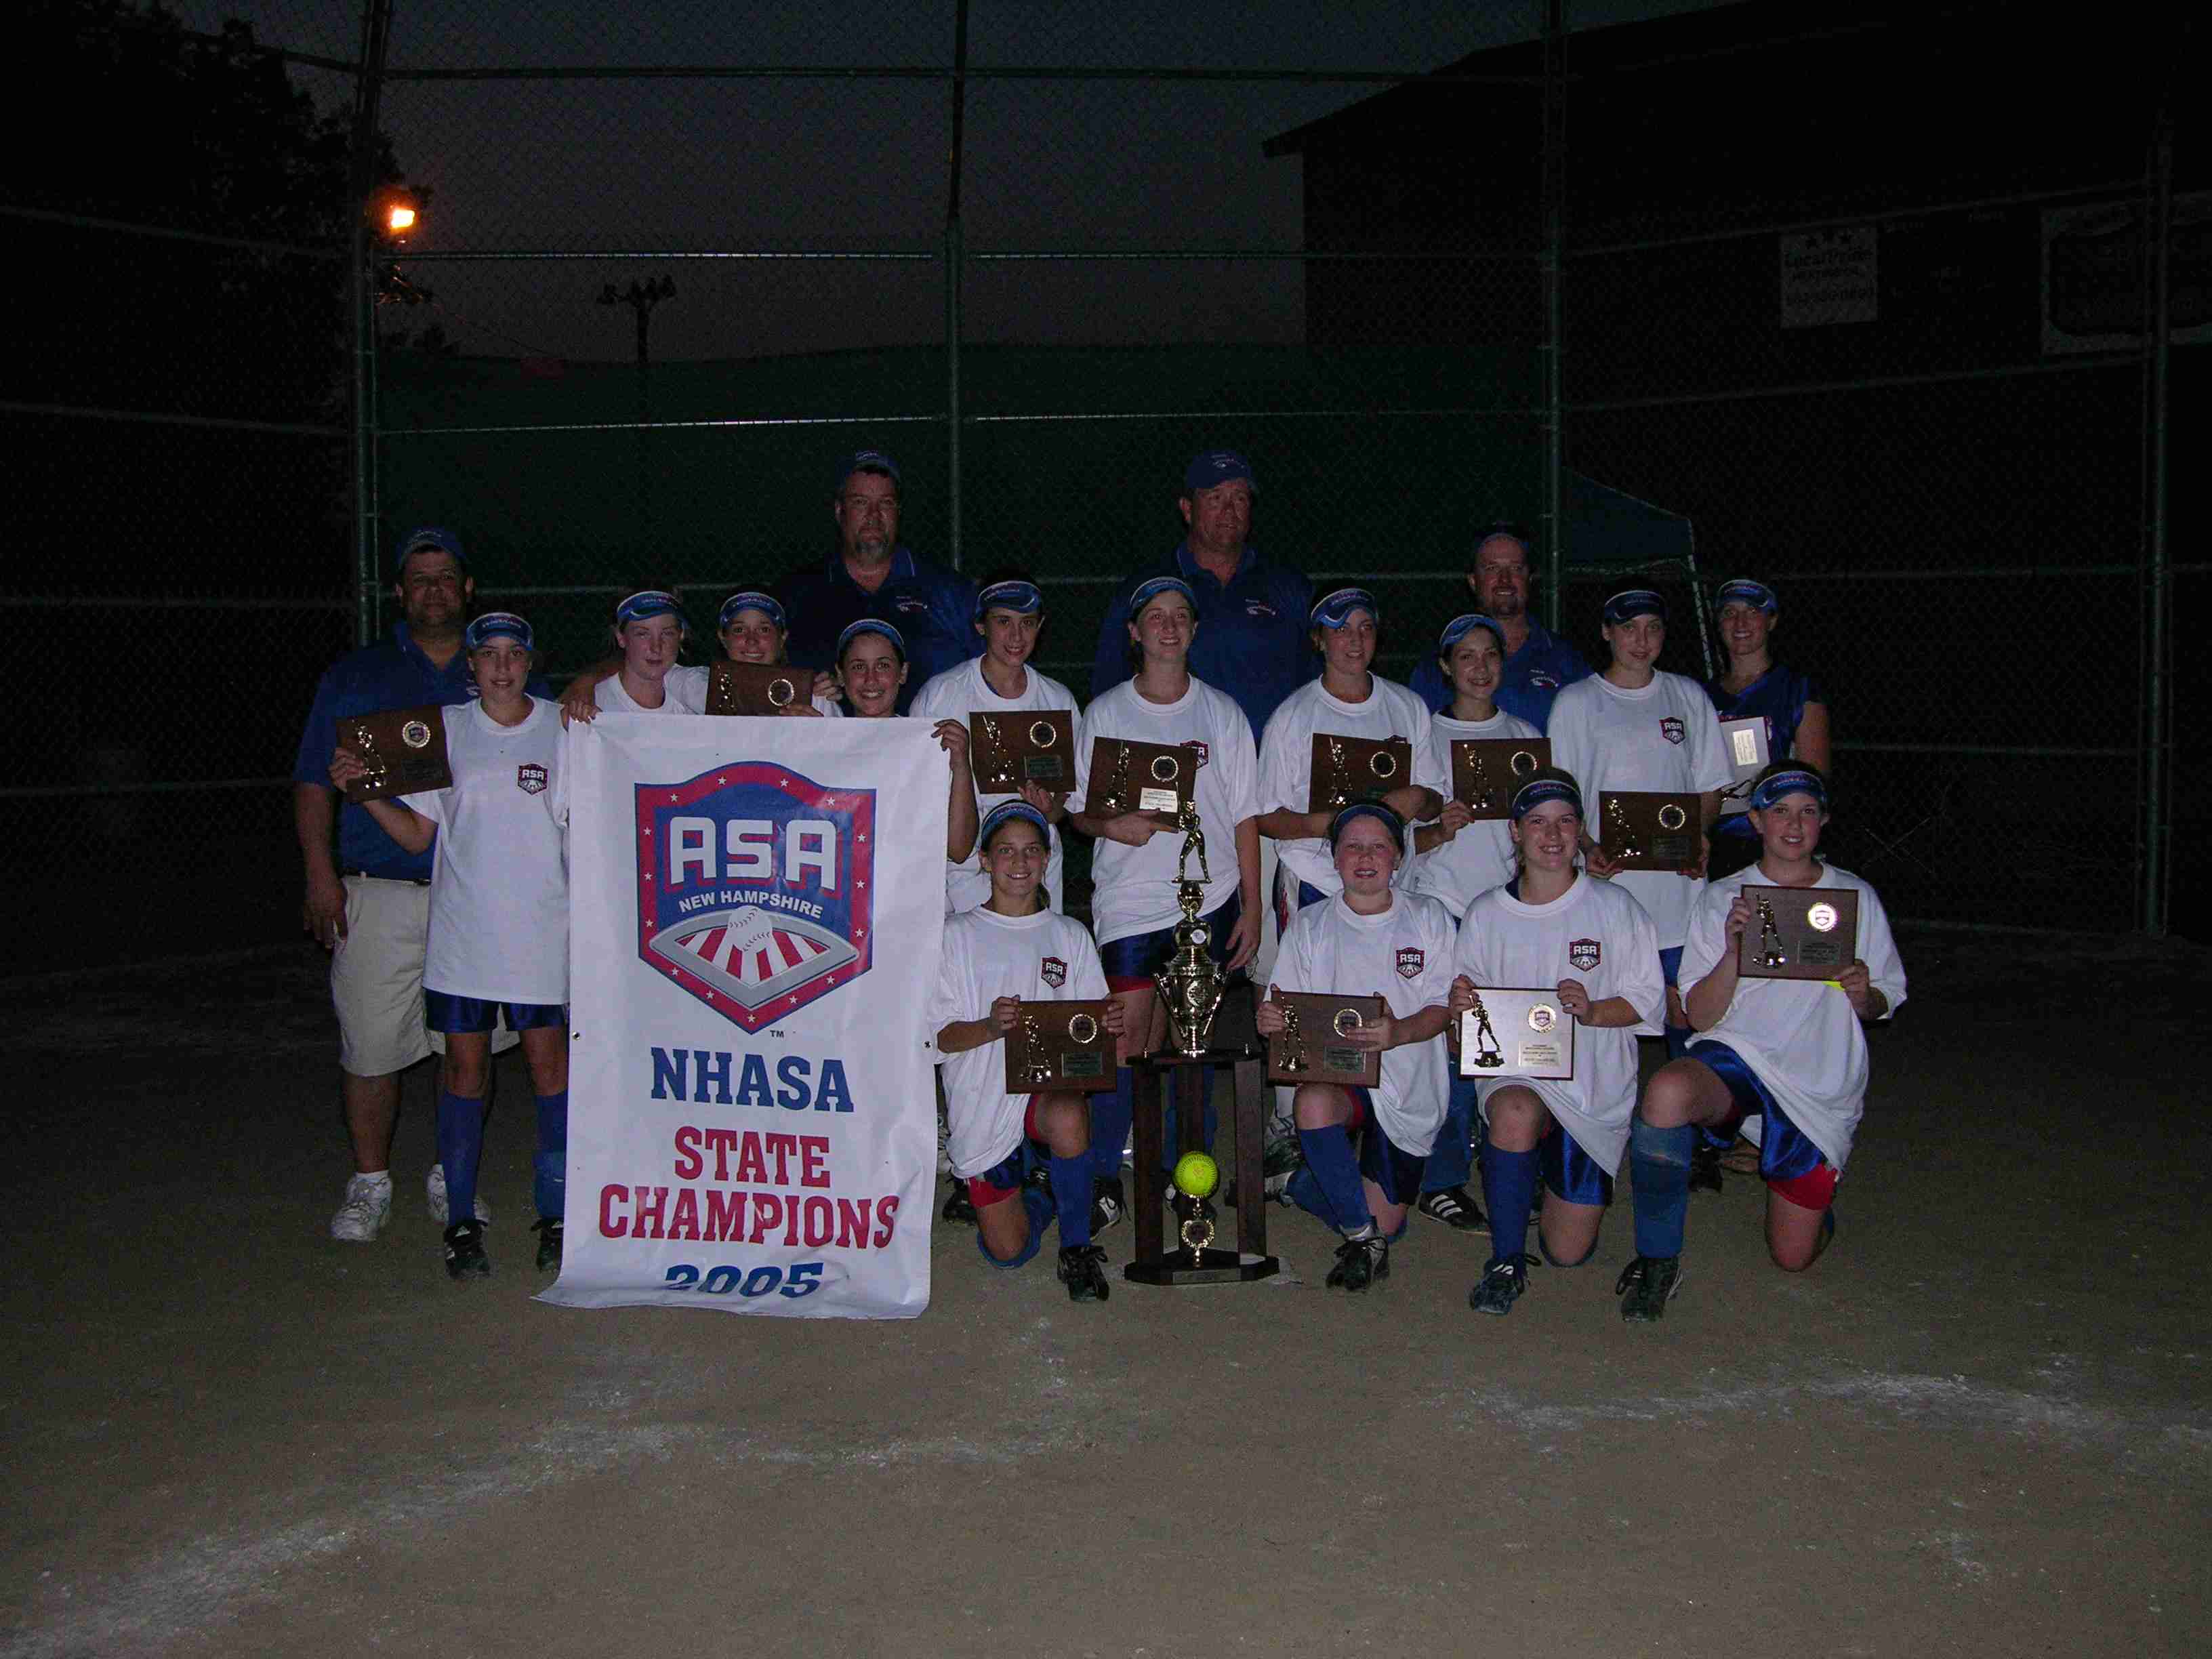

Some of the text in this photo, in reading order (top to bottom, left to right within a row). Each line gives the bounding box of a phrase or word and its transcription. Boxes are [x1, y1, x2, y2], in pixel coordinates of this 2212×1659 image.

[521, 769, 545, 780] ASA
[669, 816, 837, 890] ASA
[678, 889, 824, 919] NEW HAMPSHIRE
[1399, 953, 1420, 964] ASA
[1573, 945, 1597, 955] ASA
[1045, 961, 1063, 975] ASA
[770, 1029, 785, 1038] TM
[650, 1046, 855, 1113] NHASA
[674, 1126, 830, 1189] STATE
[598, 1183, 901, 1250] CHAMPIONS
[664, 1262, 825, 1298] 2005
